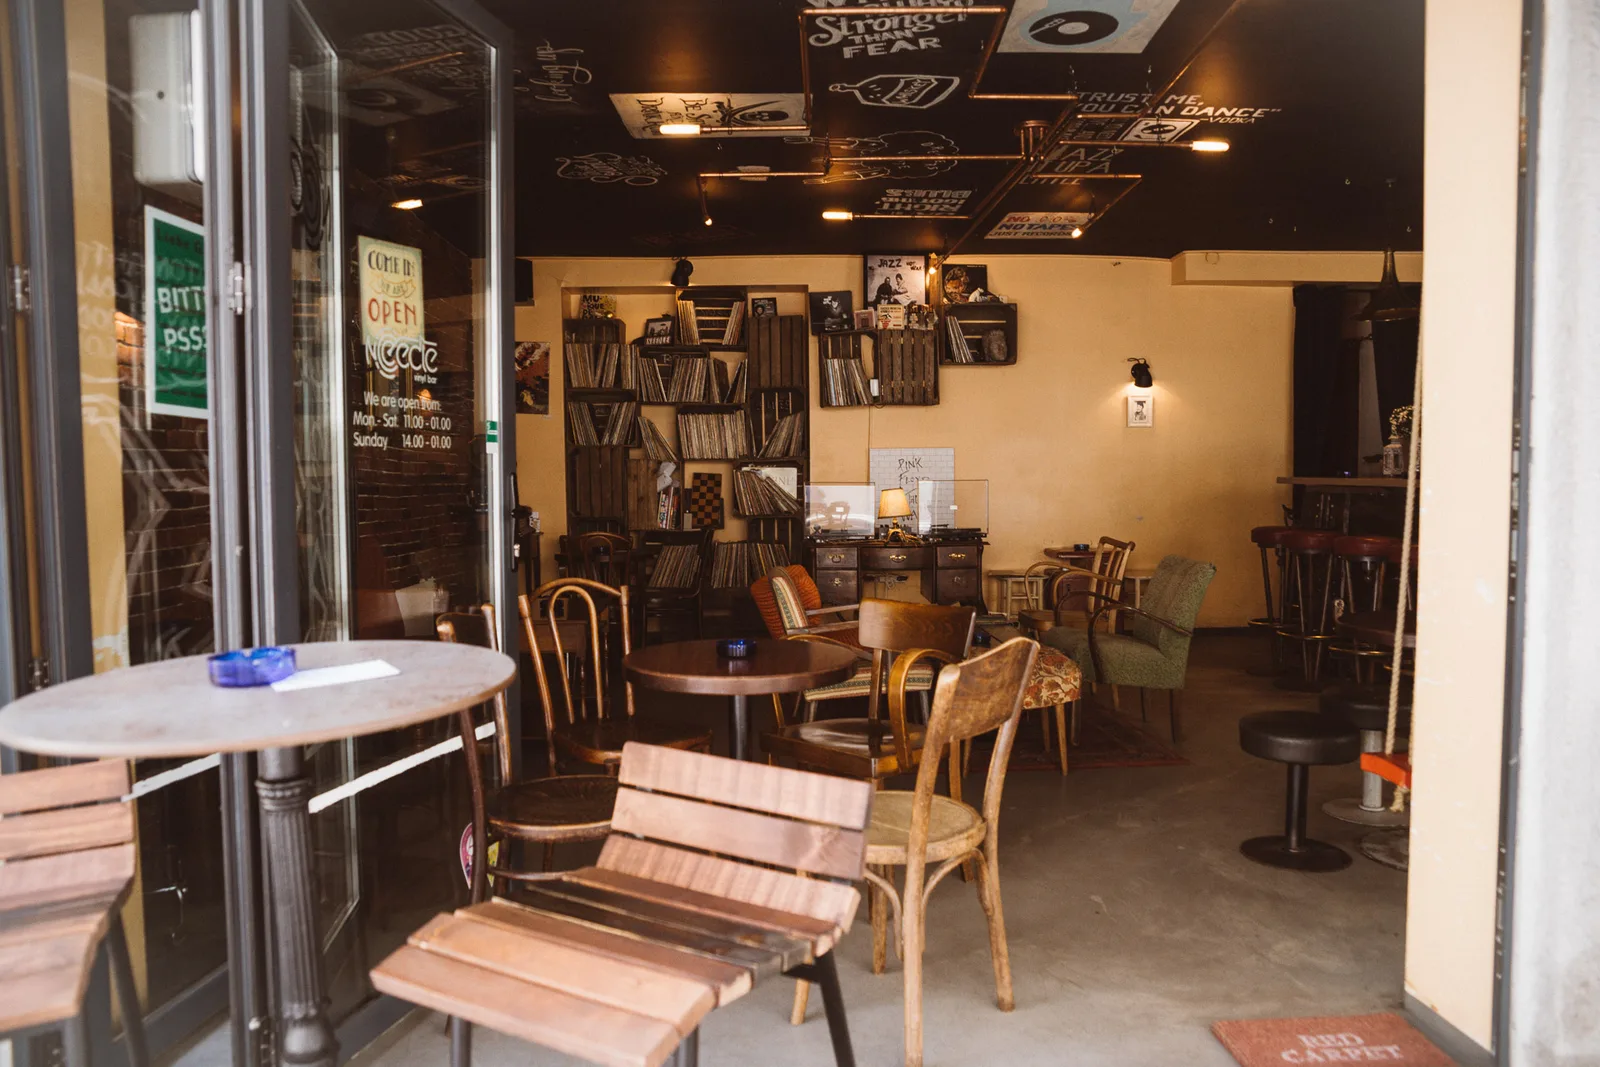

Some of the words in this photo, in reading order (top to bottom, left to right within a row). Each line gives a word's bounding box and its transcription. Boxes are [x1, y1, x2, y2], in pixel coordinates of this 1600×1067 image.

[848, 28, 914, 44] THAN
[842, 36, 943, 59] FEAR
[1077, 102, 1119, 113] OU
[1054, 160, 1091, 173] UP
[367, 250, 400, 275] COME
[402, 258, 416, 277] IN
[877, 258, 902, 269] JAZZ
[157, 286, 206, 314] BITT
[367, 297, 417, 326] OPEN
[427, 375, 438, 385] bar
[363, 391, 380, 406] We
[381, 395, 396, 407] are
[398, 397, 420, 411] open
[403, 414, 424, 430] 11.00
[430, 416, 452, 431] 01.00
[353, 432, 389, 451] Sunday
[402, 433, 424, 449] 14.00
[430, 435, 452, 449] 01.00
[898, 456, 924, 473] PINK
[1296, 1033, 1365, 1049] RED
[1281, 1044, 1404, 1064] CARPET
